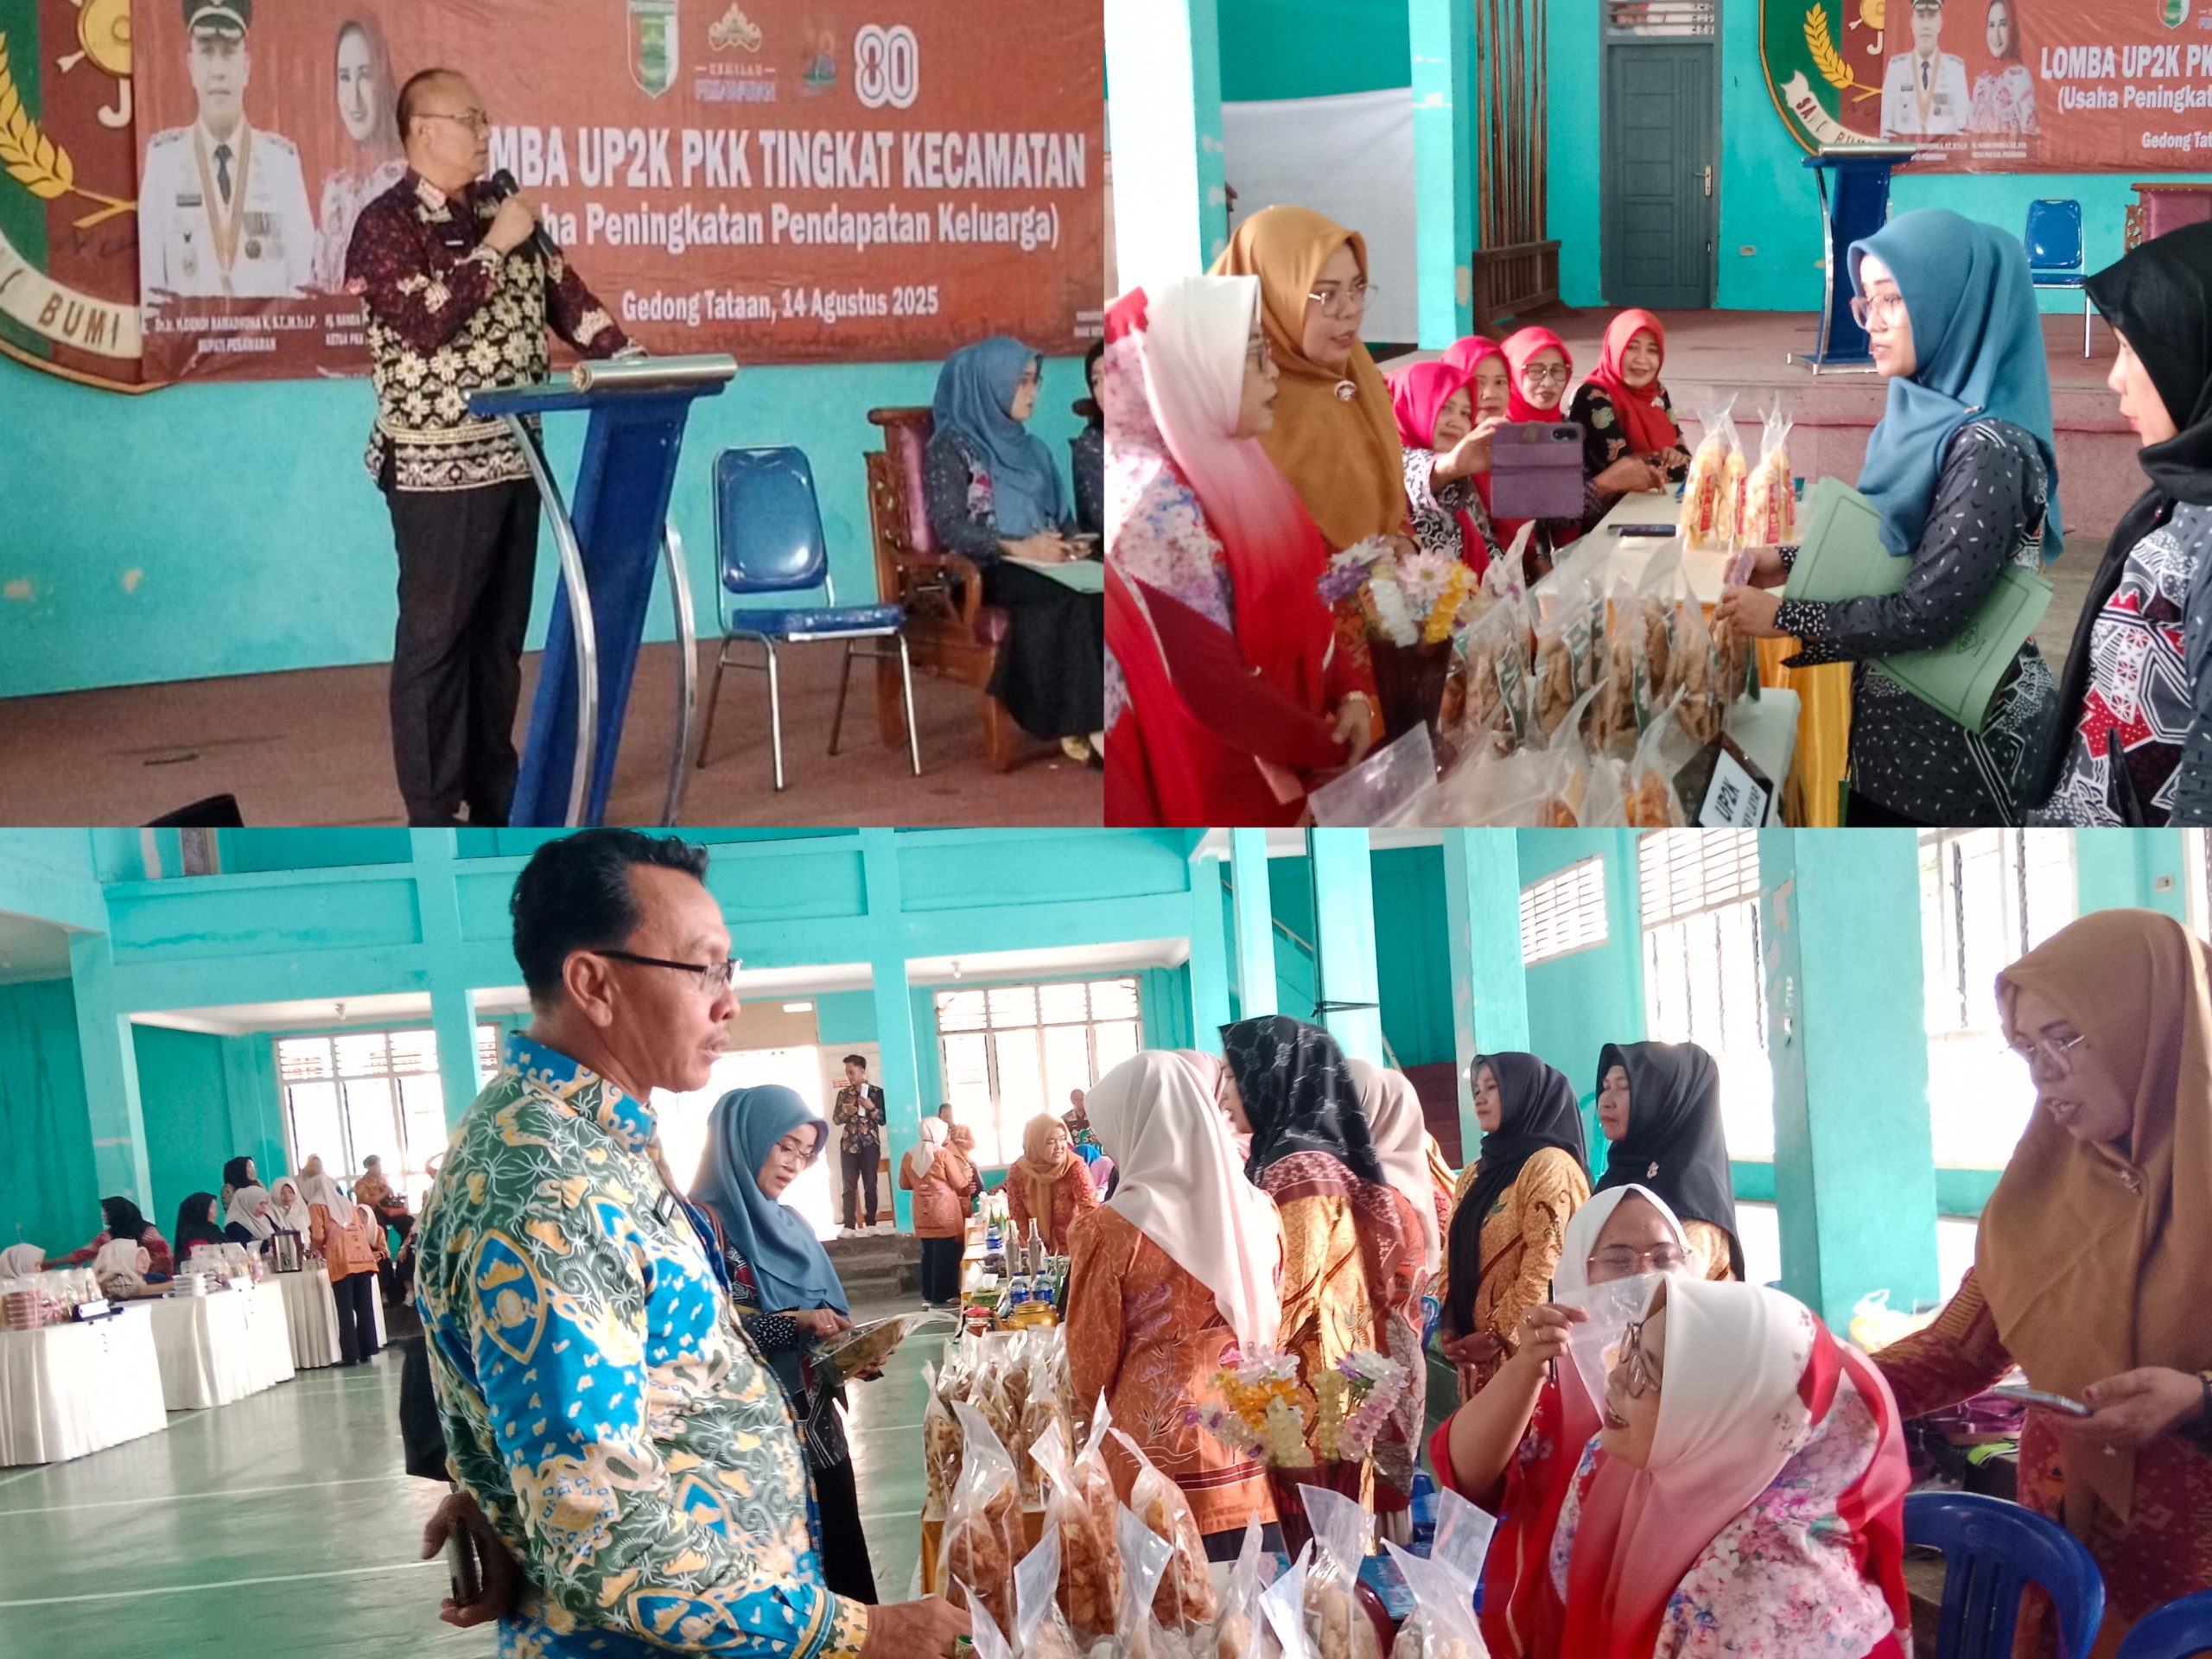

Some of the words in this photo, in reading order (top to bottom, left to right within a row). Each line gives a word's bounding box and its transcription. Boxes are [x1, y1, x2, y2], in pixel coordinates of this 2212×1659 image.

[855, 24, 918, 109] 80
[2040, 47, 2116, 79] LOMBA
[2122, 44, 2181, 78] UP2K
[2186, 44, 2212, 77] PK
[2057, 86, 2119, 114] (Usaha
[2123, 84, 2212, 113] Peningkat
[489, 125, 569, 187] MBA
[578, 127, 673, 188] UP2K
[681, 129, 752, 188] PKK
[759, 130, 893, 188] TINGKAT
[903, 131, 1085, 188] KECAMATAN
[2141, 131, 2191, 152] Gedong
[2194, 131, 2212, 149] Tat
[586, 200, 764, 254] Peningkatan
[771, 202, 931, 252] Pendapatan
[938, 201, 1059, 251] Keluarga)
[38, 291, 119, 350] BUMI
[622, 289, 701, 327] Gedong
[703, 289, 776, 324] Tataan,
[781, 288, 805, 319] 14
[810, 288, 887, 323] Agustus
[892, 286, 939, 316] 2025
[1714, 776, 1740, 823] UP2K
